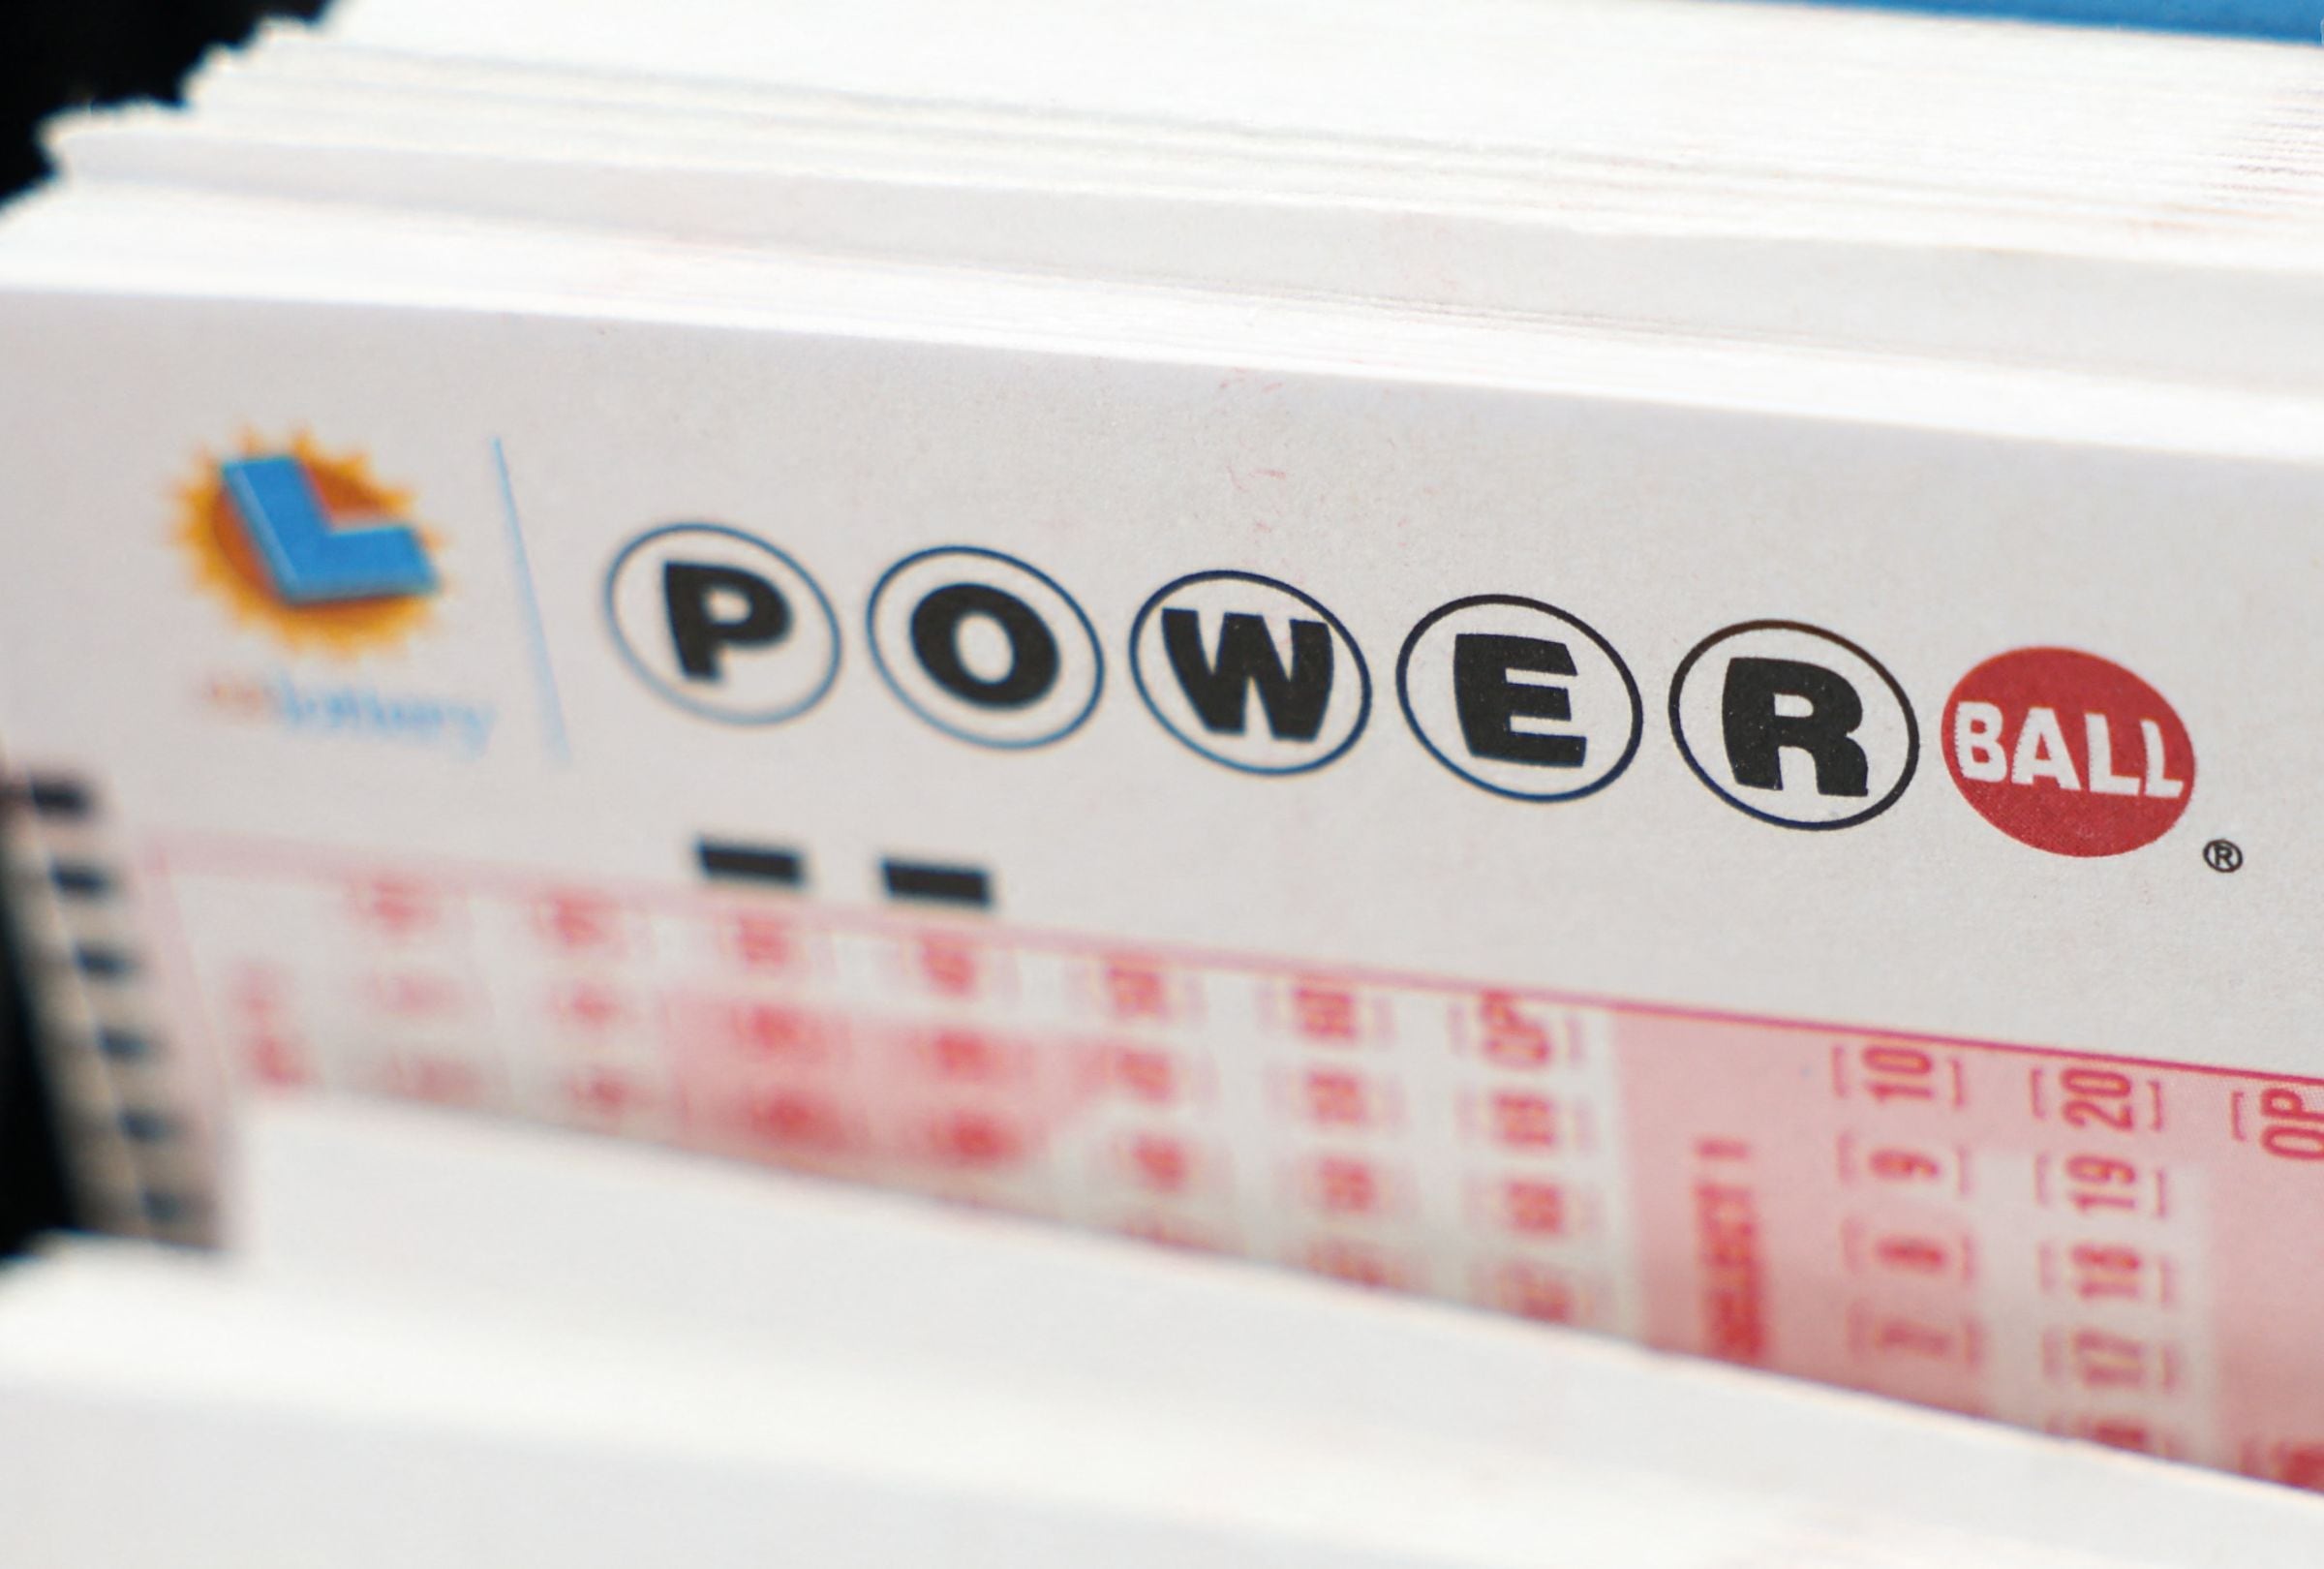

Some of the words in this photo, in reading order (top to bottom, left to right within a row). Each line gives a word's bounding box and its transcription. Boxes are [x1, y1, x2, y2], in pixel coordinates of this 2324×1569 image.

[1863, 1046, 1935, 1101] 10
[2061, 1067, 2134, 1131] 20
[2065, 1154, 2136, 1212] 19
